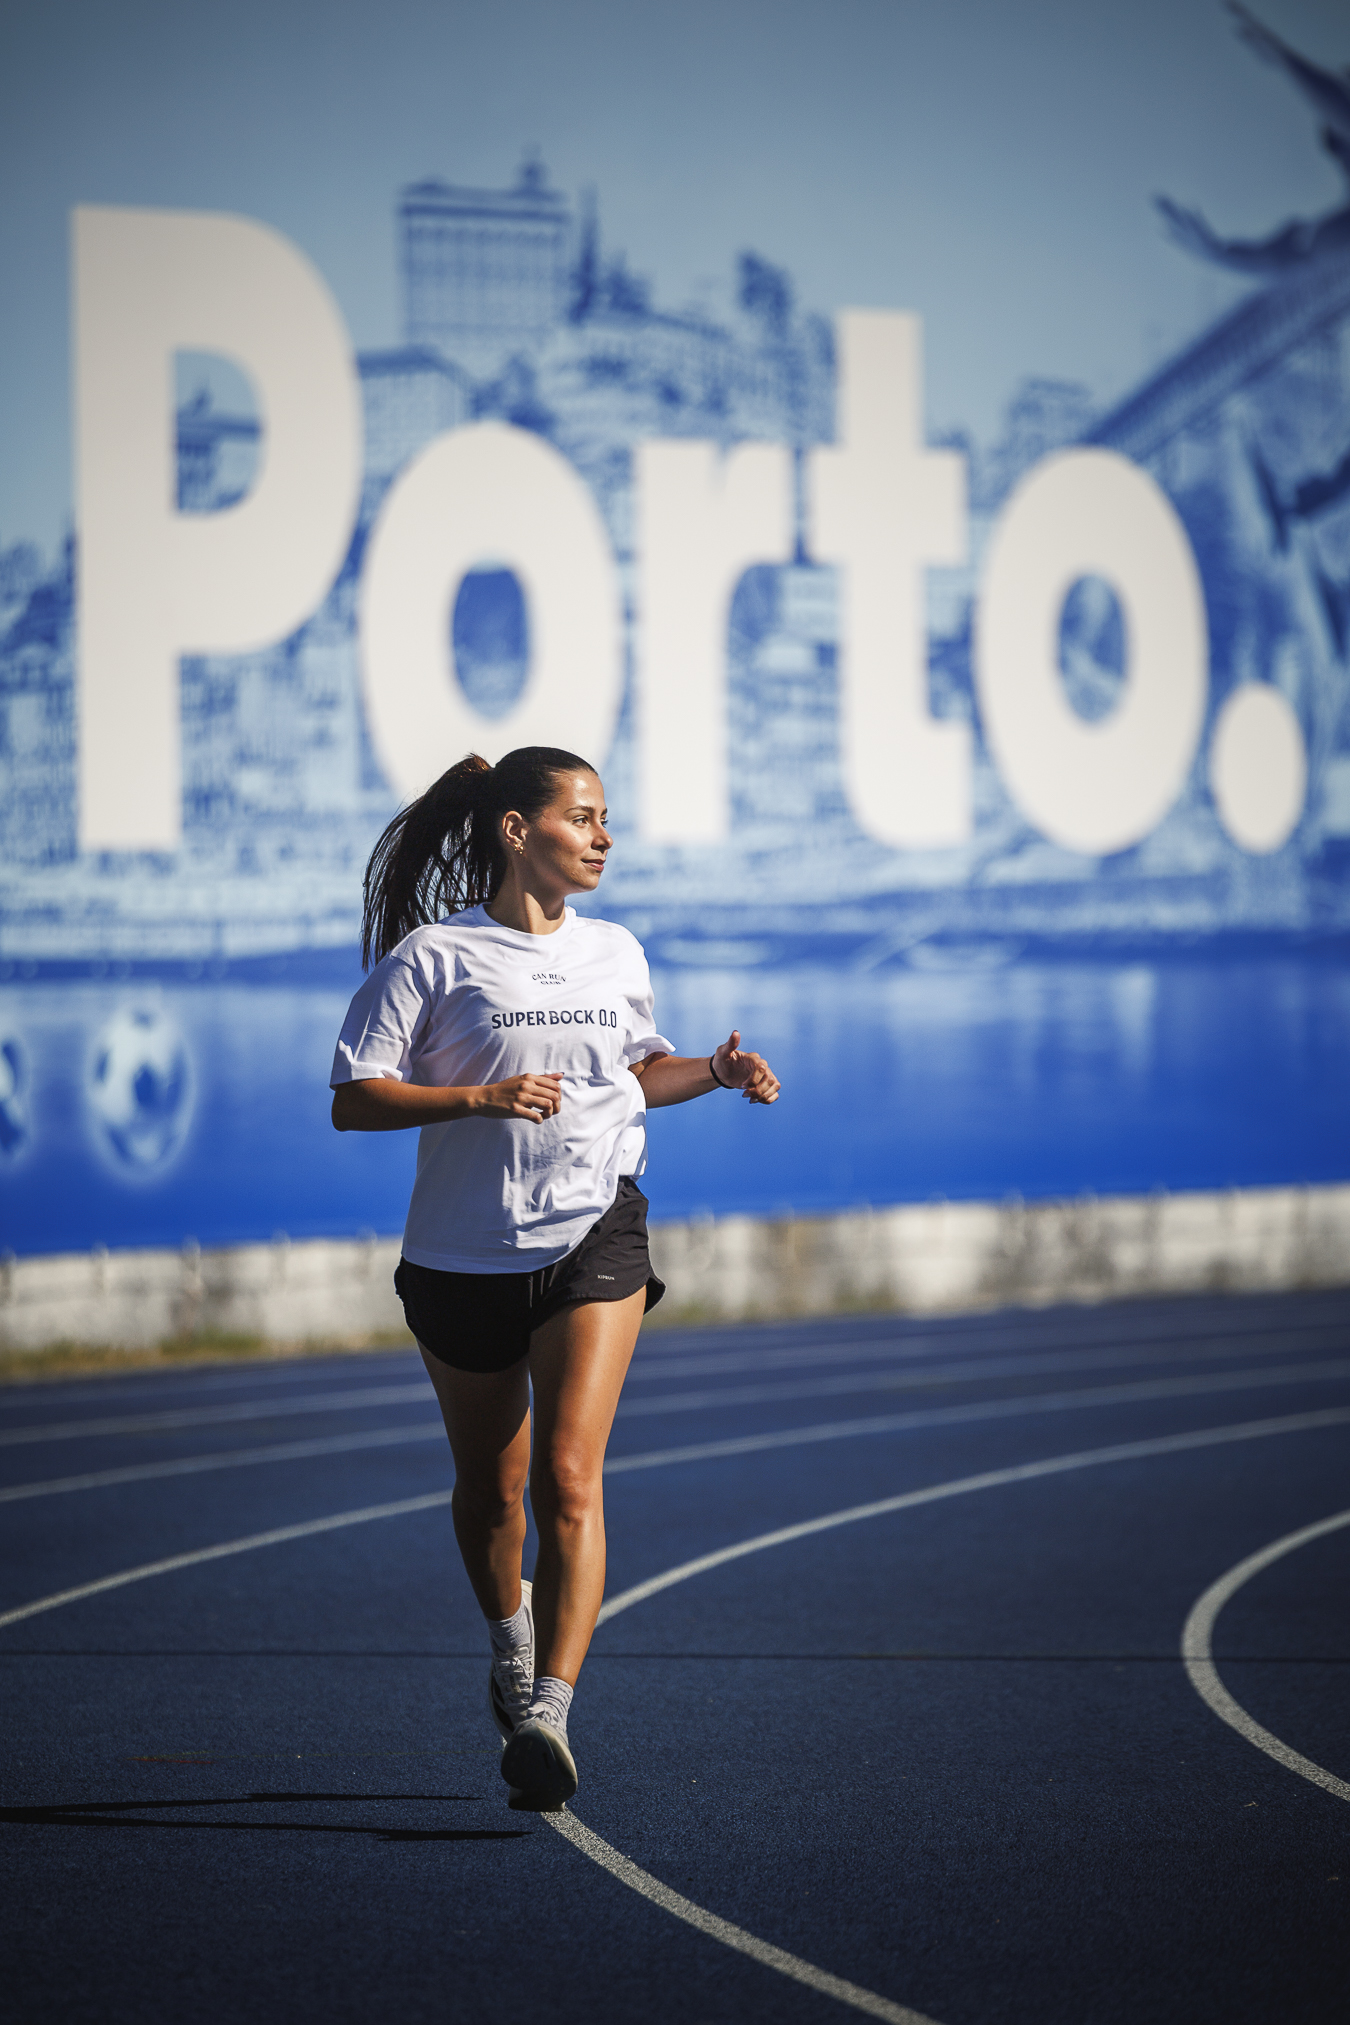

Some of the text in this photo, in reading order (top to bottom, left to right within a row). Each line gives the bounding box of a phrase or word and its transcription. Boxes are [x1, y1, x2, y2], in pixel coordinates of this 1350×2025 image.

[72, 204, 1307, 855] Porto.
[532, 973, 566, 982] CAN RUN
[492, 1009, 617, 1029] SUPER BOCK 0.0
